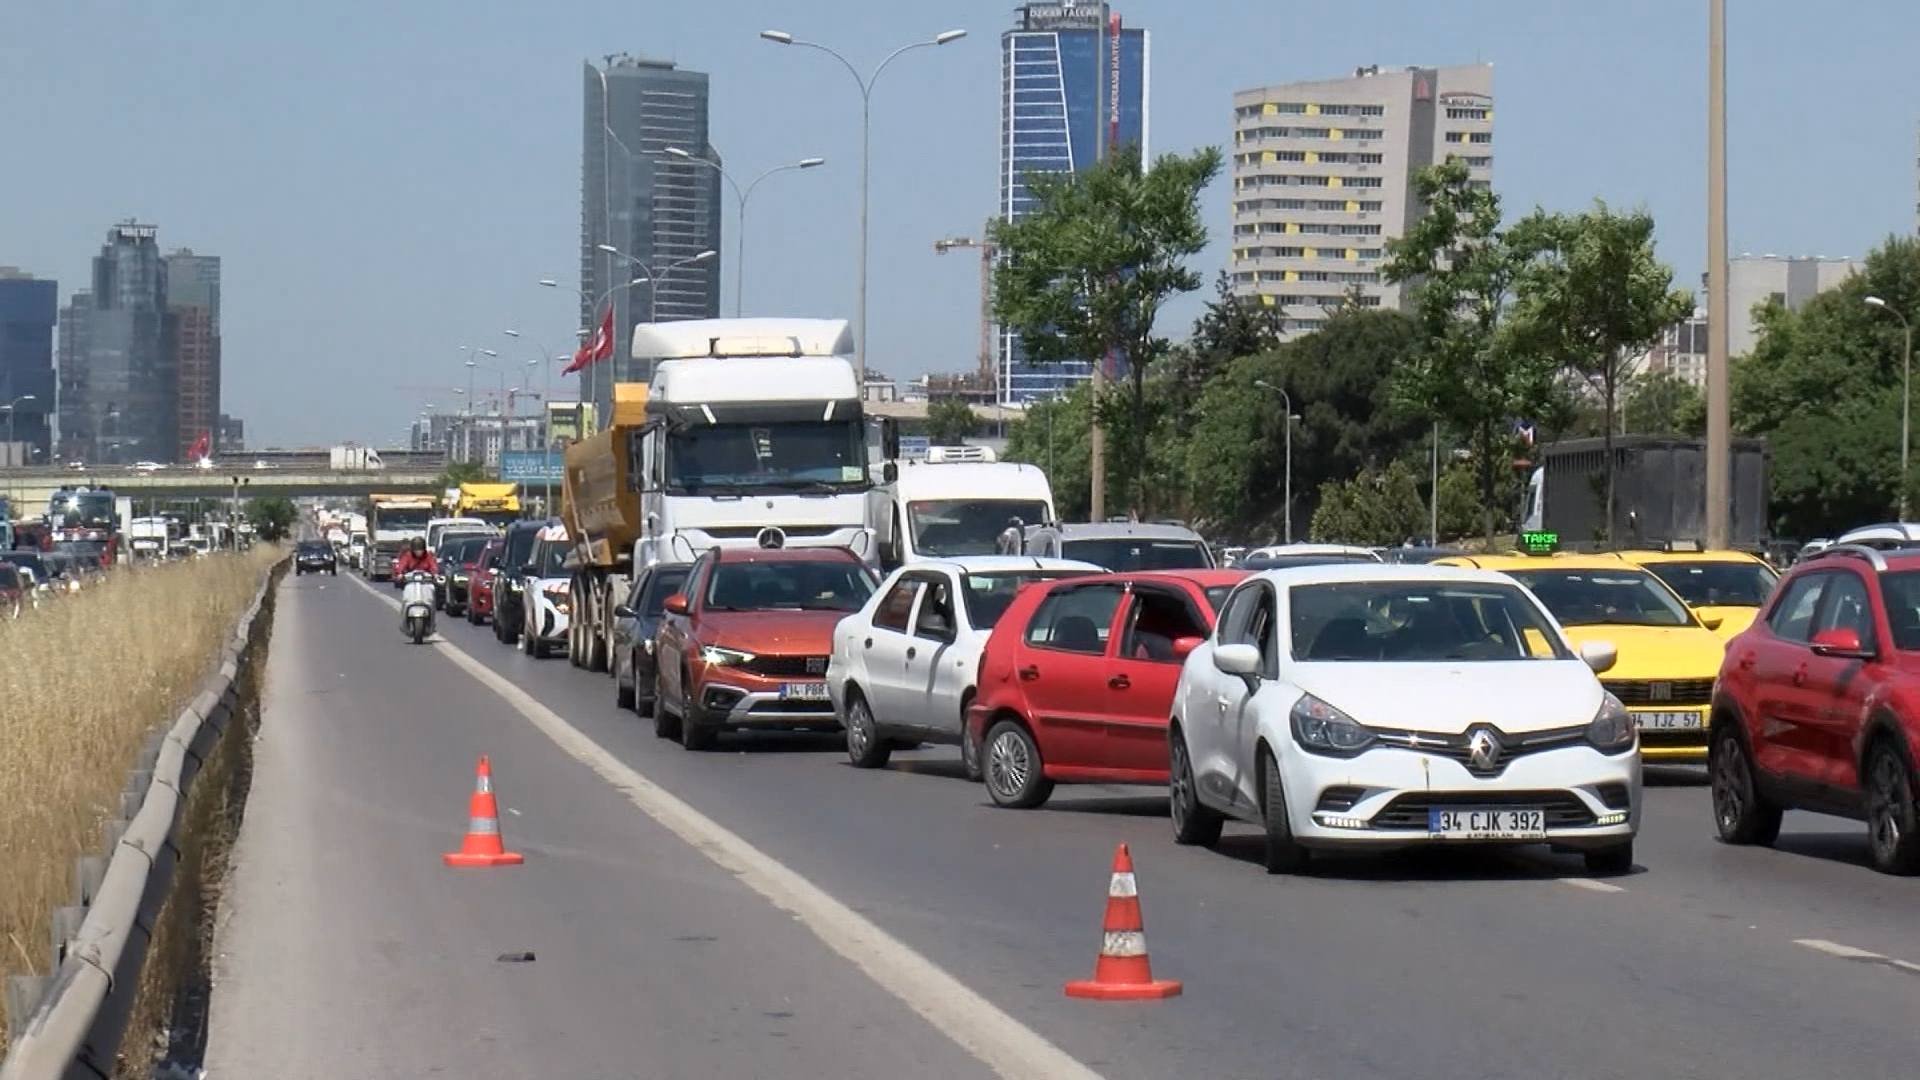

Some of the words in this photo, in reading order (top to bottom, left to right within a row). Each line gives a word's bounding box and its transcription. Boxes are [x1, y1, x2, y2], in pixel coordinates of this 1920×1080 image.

[1654, 714, 1675, 727] TJZ
[1683, 714, 1697, 727] 57
[1441, 812, 1462, 831] 34
[1470, 812, 1501, 831] CJK
[1509, 812, 1540, 831] 392
